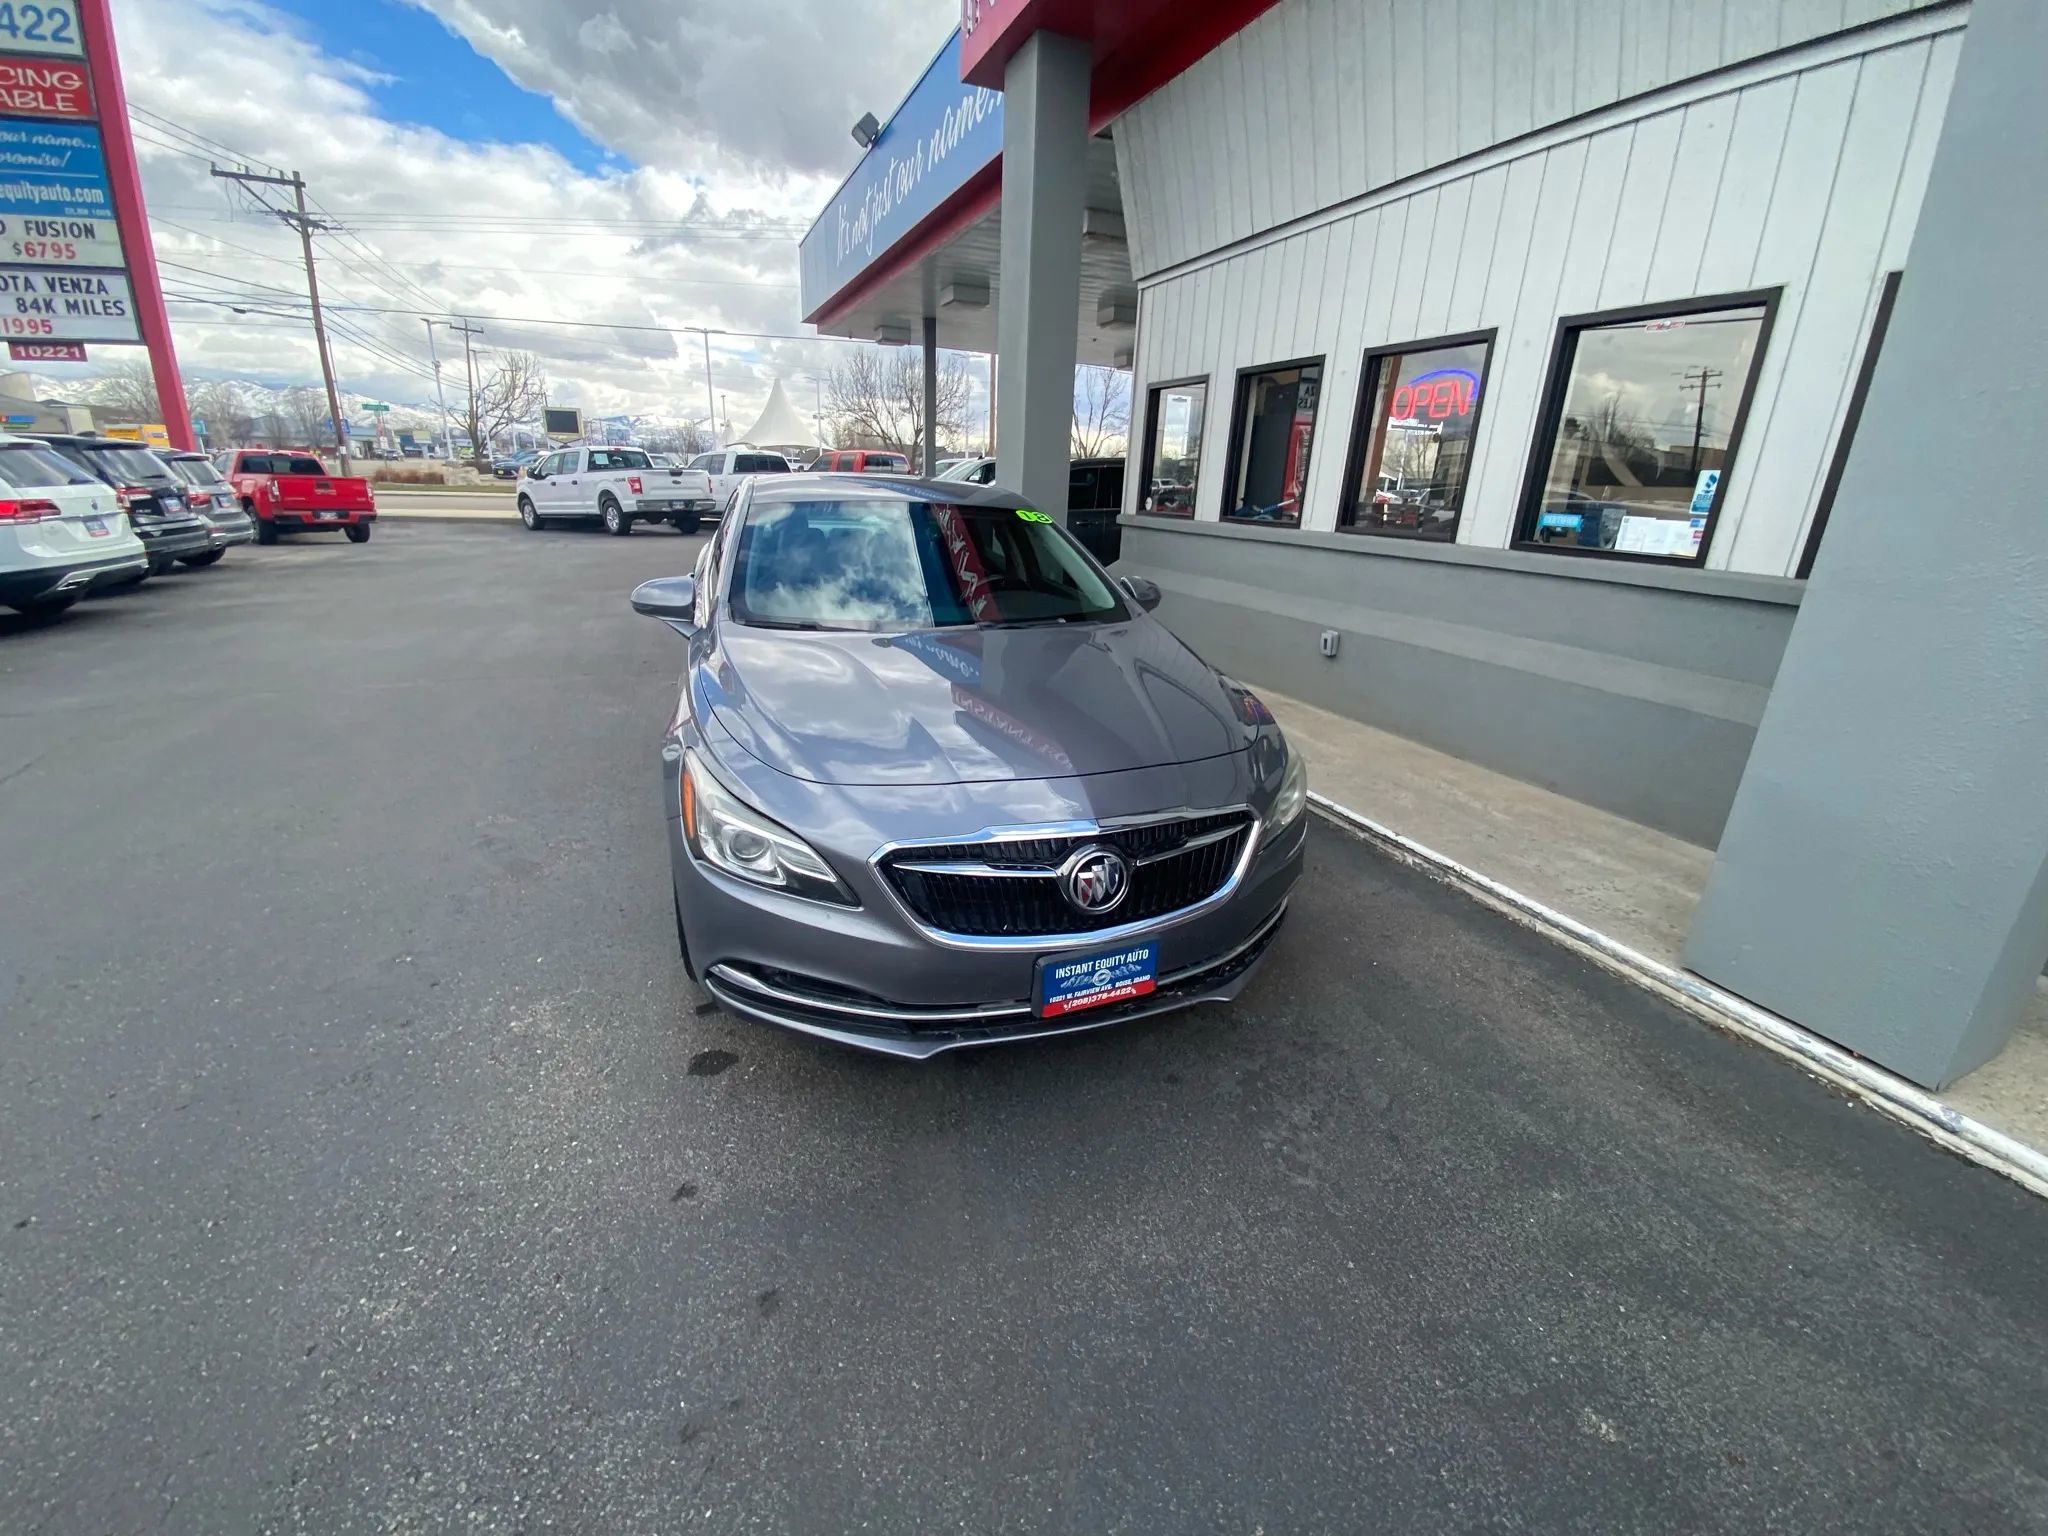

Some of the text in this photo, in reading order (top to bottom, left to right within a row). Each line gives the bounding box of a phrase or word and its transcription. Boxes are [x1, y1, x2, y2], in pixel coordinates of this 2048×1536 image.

[851, 185, 874, 251] not
[866, 156, 899, 257] just
[896, 139, 924, 205] our
[24, 220, 96, 239] FUSION
[12, 241, 77, 260] $6795
[0, 274, 110, 295] OTA VENZA
[16, 297, 126, 317] 84K MILES
[16, 345, 81, 359] 10221
[1392, 379, 1473, 421] OPEN
[1055, 948, 1149, 979] INSTANT EQUITY AUTO
